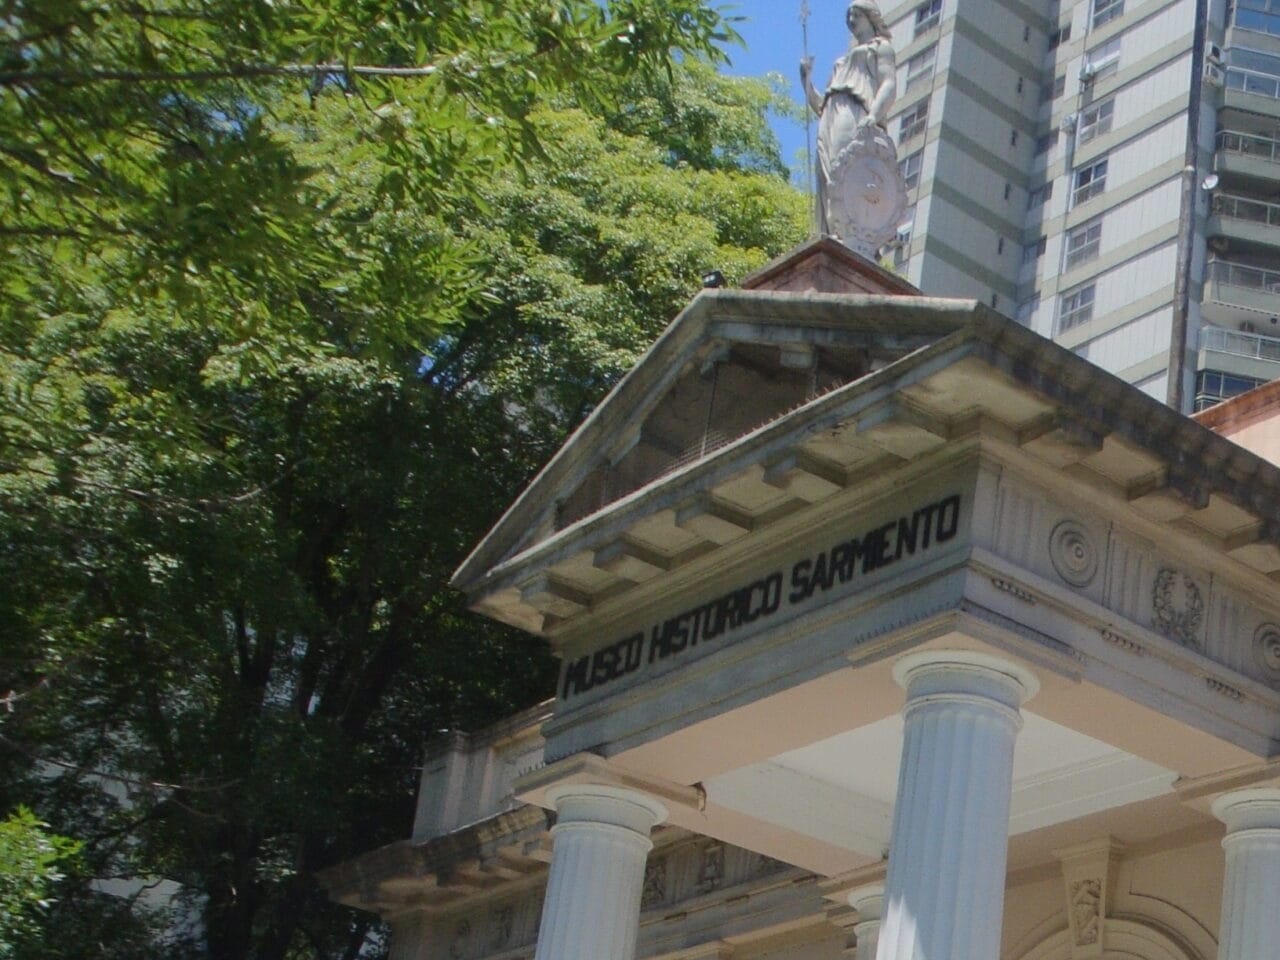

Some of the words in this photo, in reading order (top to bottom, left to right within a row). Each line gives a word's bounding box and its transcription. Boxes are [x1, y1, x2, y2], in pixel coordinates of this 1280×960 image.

[562, 631, 645, 700] MUSEO
[648, 571, 784, 665] HISTORICO
[789, 494, 962, 605] SARMIENTO
